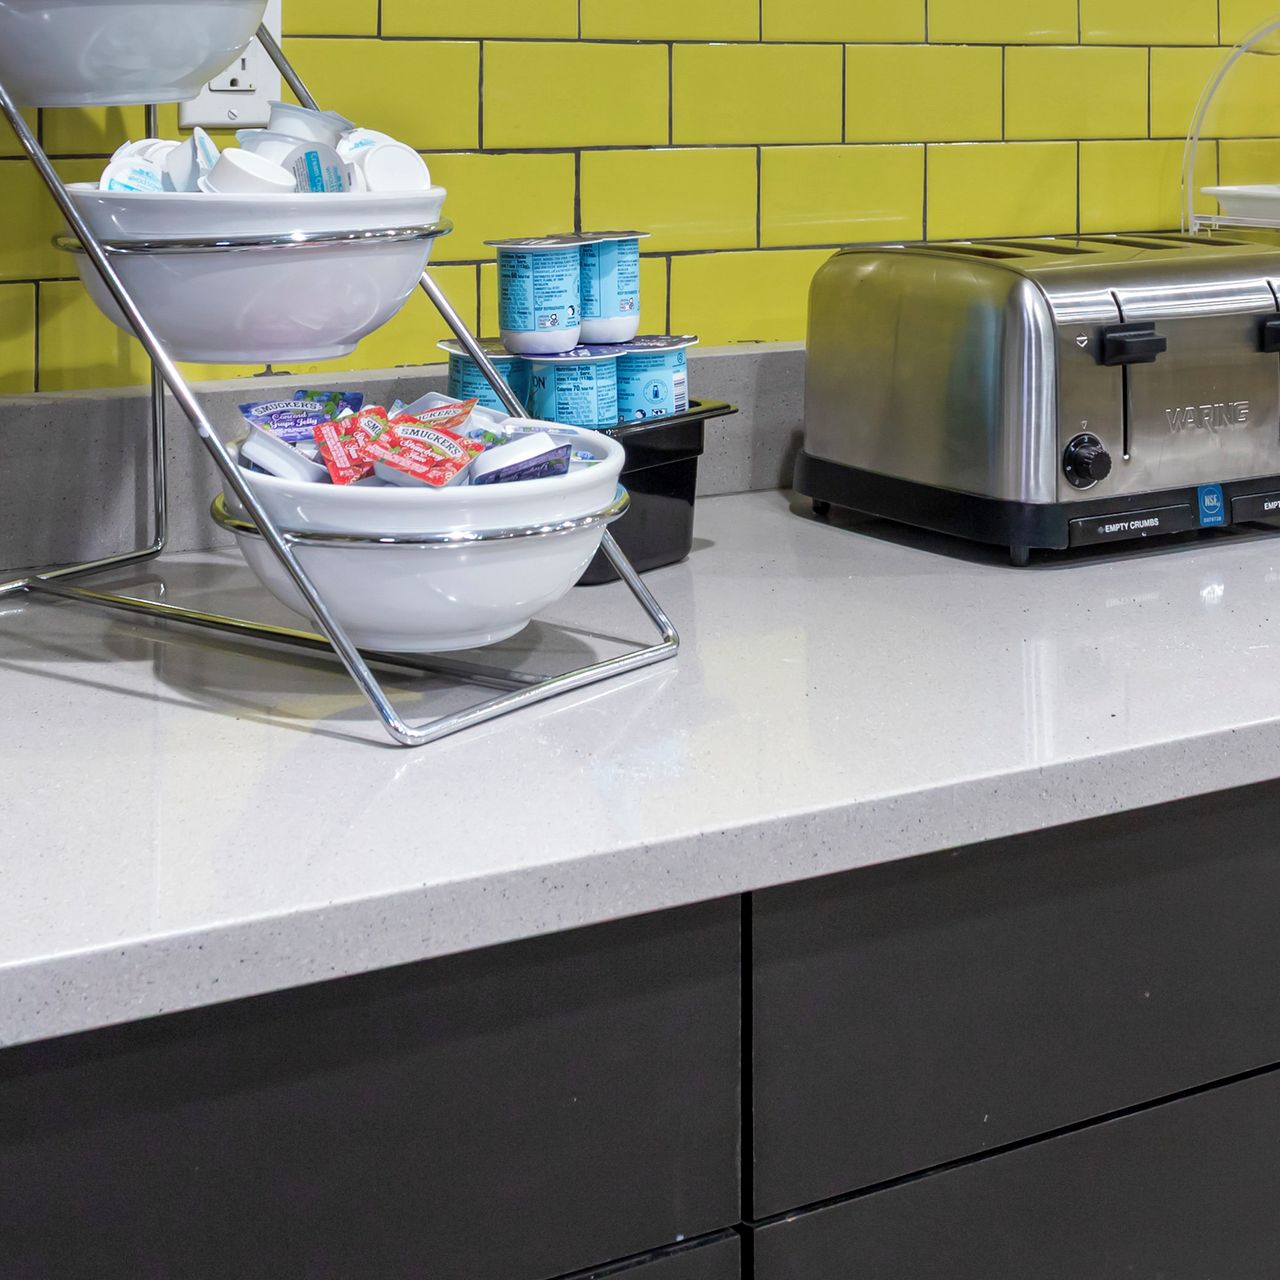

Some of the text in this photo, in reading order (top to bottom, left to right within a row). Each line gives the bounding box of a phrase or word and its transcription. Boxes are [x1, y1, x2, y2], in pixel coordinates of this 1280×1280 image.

[269, 418, 318, 429] Grape Jelly
[1165, 400, 1249, 433] WARING
[1204, 494, 1218, 507] NSF
[1104, 517, 1159, 533] EMPTY CRUMBS
